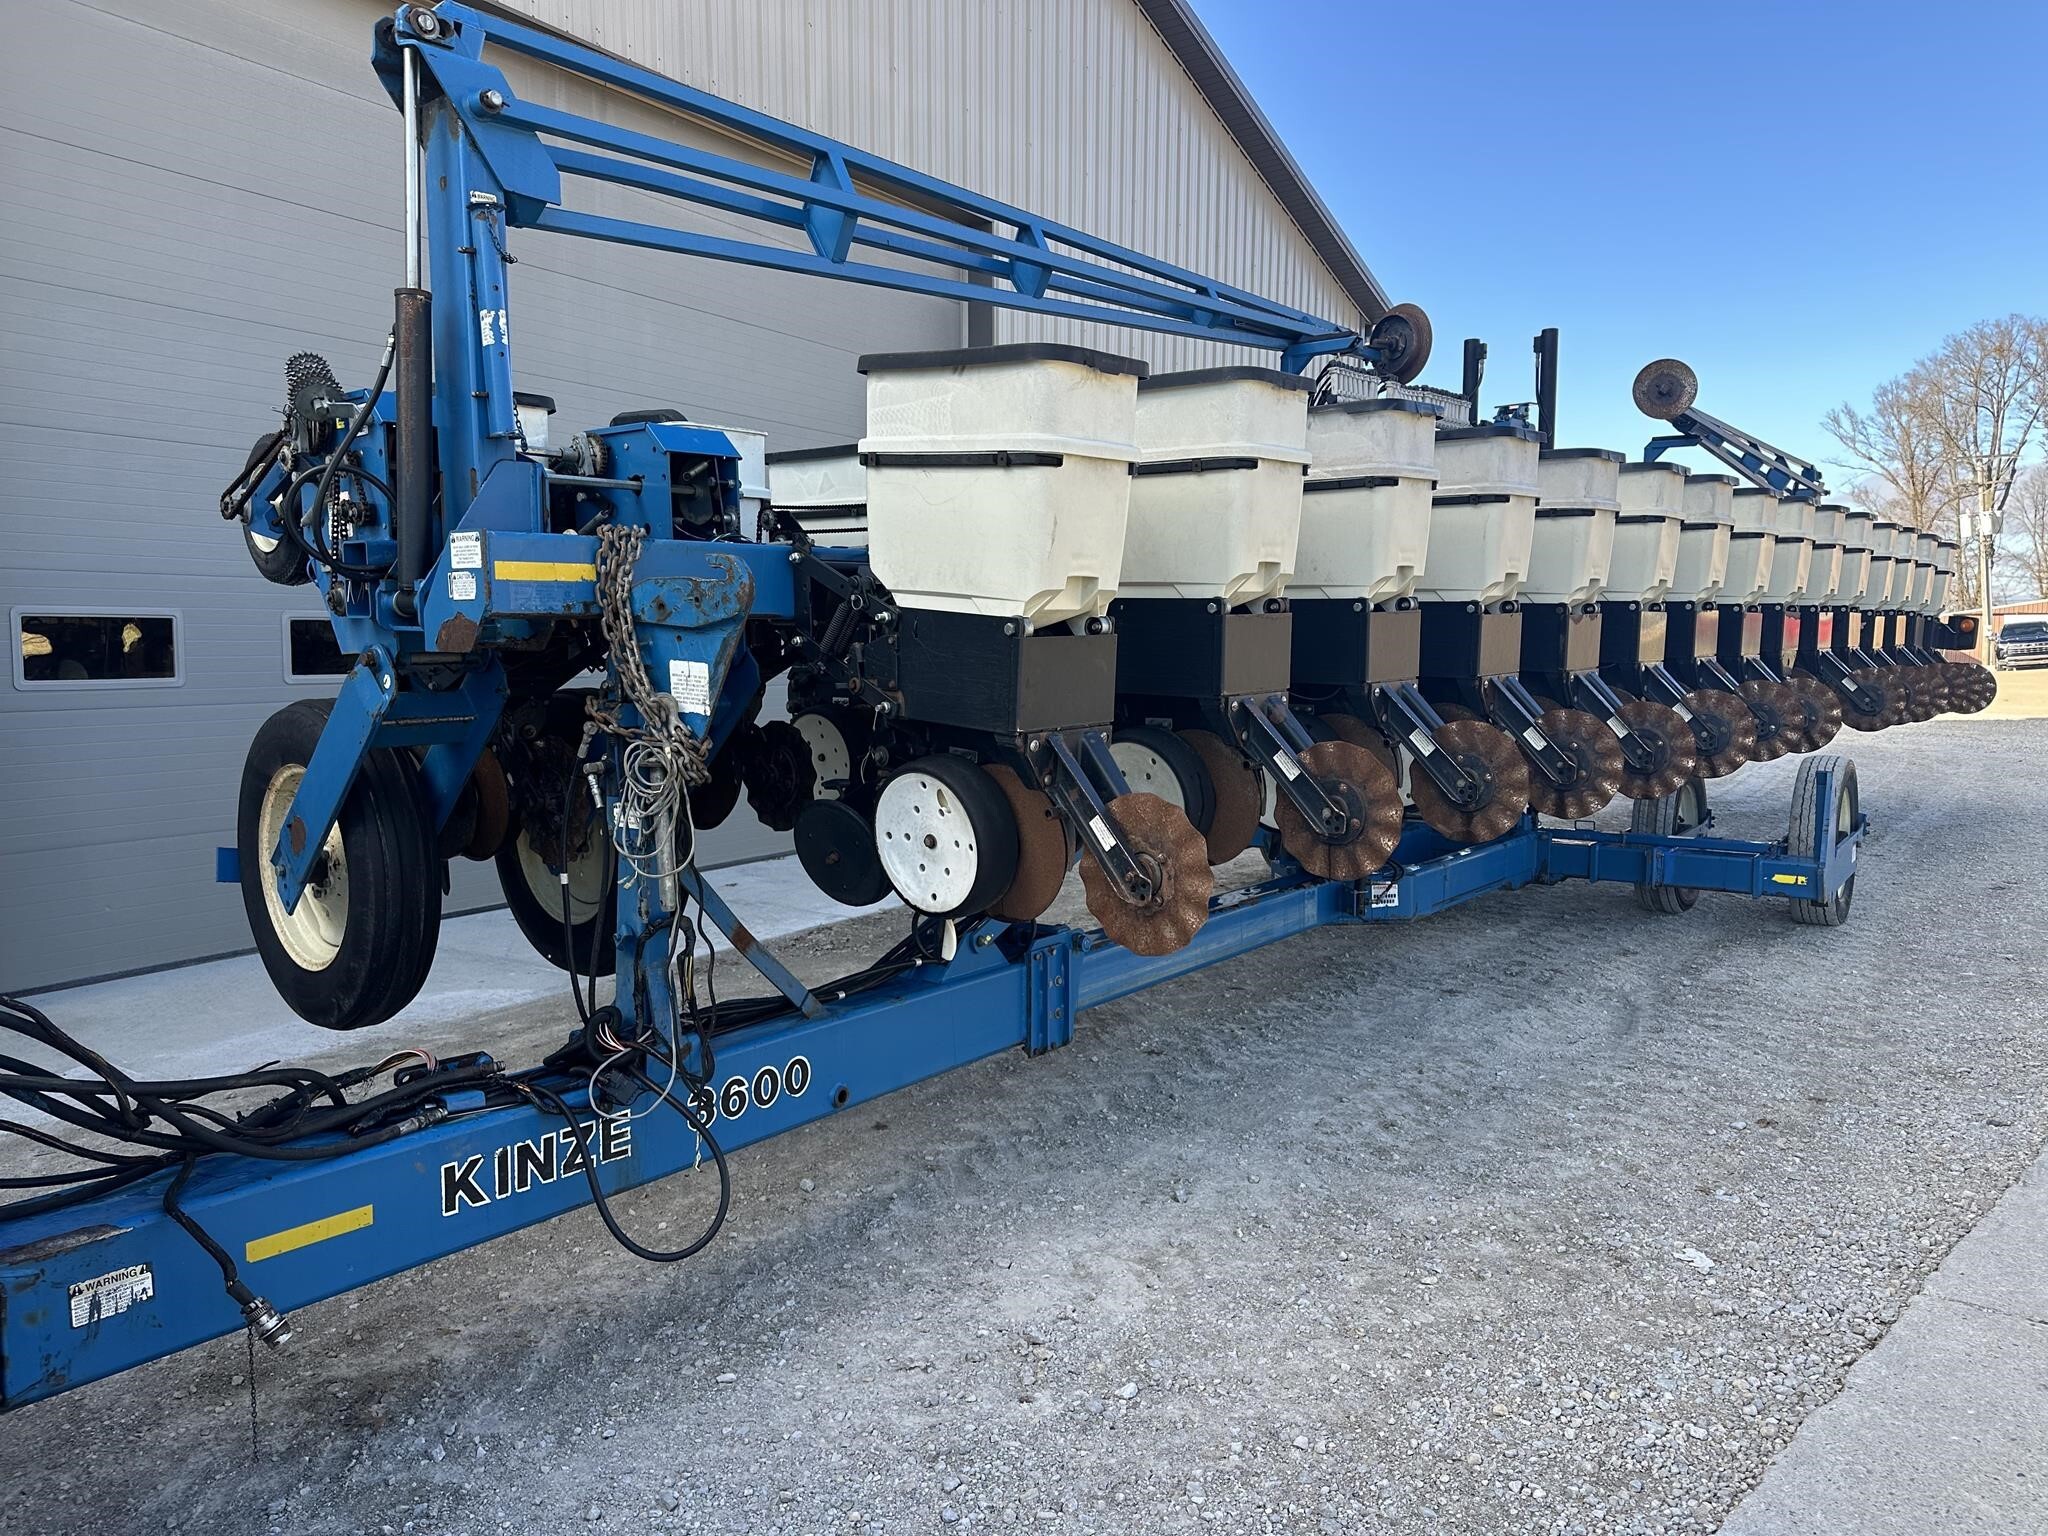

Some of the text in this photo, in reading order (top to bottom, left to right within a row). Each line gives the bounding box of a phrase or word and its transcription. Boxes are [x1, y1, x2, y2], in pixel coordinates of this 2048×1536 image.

[456, 534, 475, 542] WARNING
[686, 1055, 812, 1132] 3600
[441, 1109, 632, 1217] KINZE
[85, 1269, 137, 1292] WARNING
